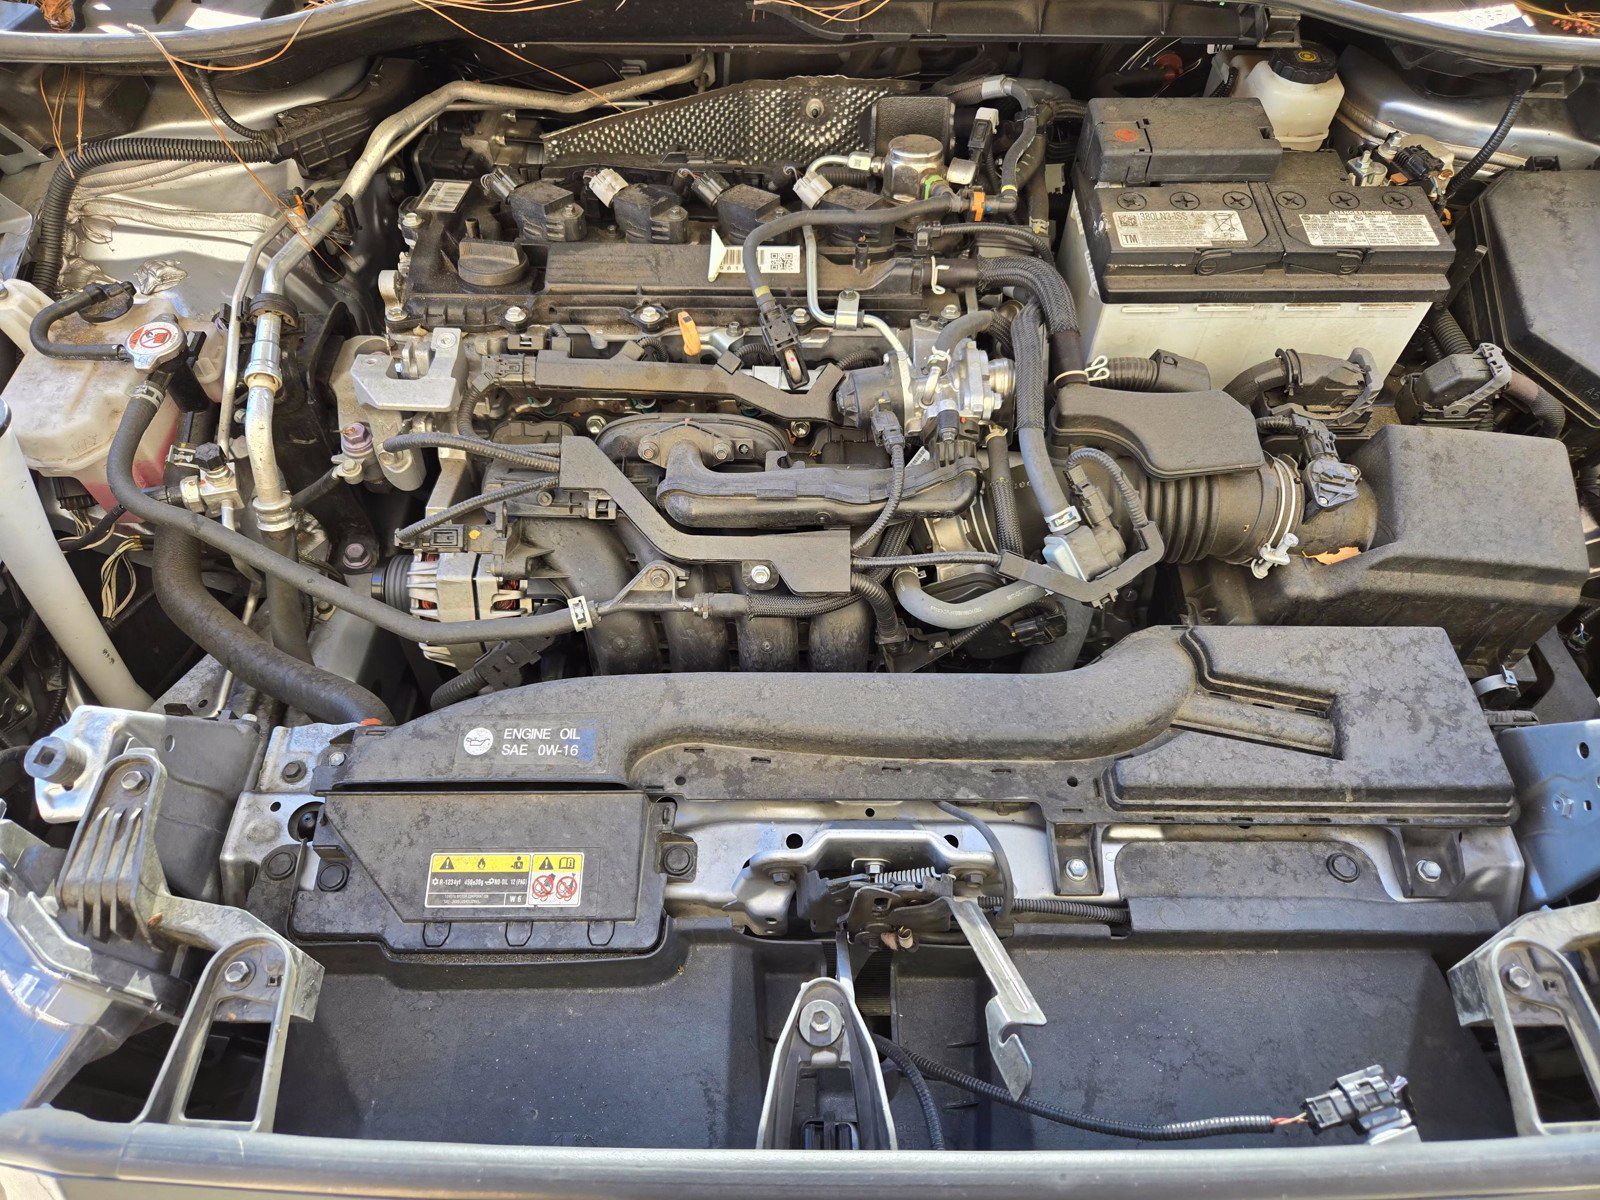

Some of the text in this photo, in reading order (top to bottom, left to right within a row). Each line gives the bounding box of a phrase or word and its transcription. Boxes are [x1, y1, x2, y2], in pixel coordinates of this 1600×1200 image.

[1123, 234, 1138, 244] TM
[503, 728, 580, 740] ENGINE OIL
[501, 744, 579, 756] SAE 0W-16
[439, 878, 461, 887] R-1234yf
[509, 895, 516, 903] W
